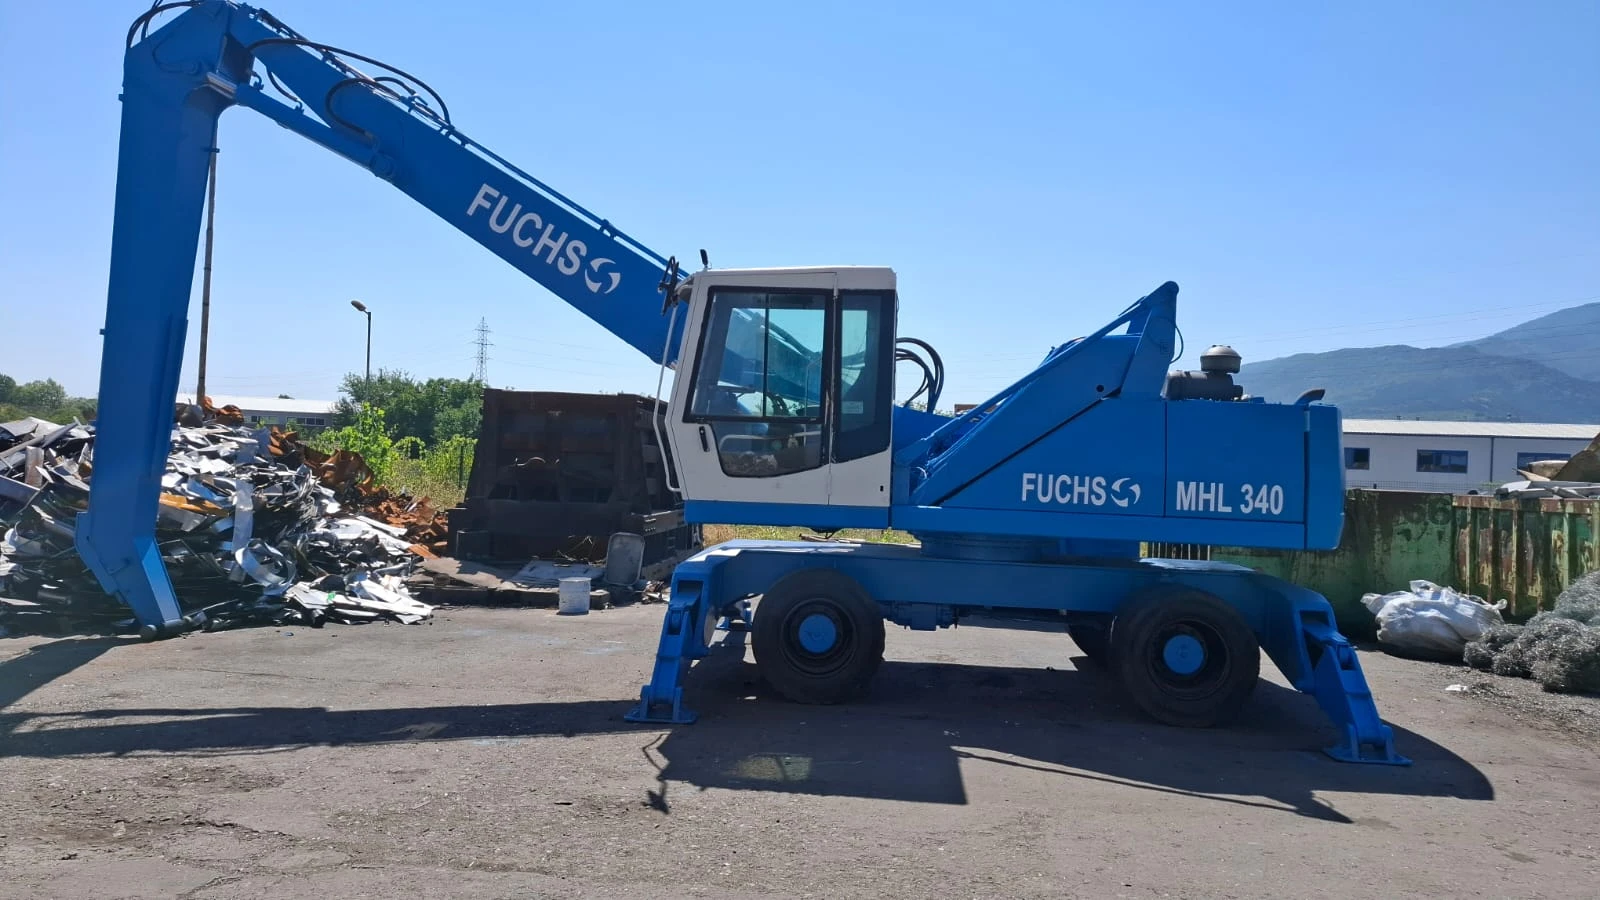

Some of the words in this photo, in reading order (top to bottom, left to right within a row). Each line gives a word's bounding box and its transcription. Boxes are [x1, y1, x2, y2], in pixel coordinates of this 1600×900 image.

[466, 183, 588, 276] FUCHS
[1021, 473, 1107, 506] FUCHS
[1176, 481, 1232, 512] MHL
[1240, 484, 1284, 515] 340
